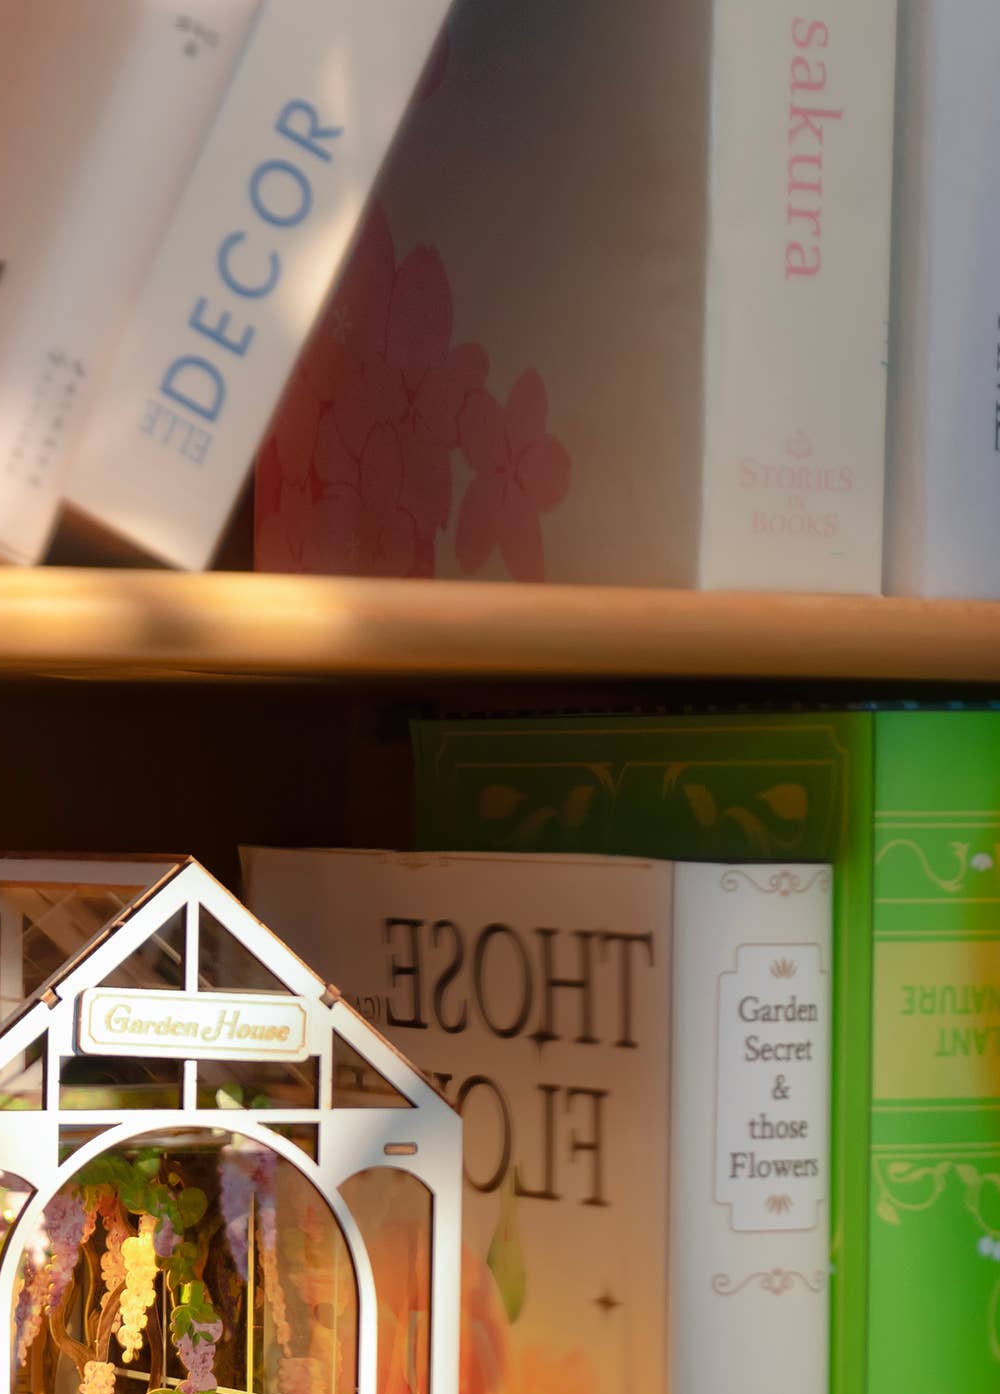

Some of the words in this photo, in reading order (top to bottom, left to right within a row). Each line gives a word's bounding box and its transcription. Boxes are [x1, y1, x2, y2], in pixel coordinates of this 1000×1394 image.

[784, 17, 844, 280] sakura
[158, 98, 343, 423] DECOR
[104, 1003, 198, 1038] Garden
[200, 1009, 290, 1042] House
[738, 996, 818, 1023] Garden
[744, 1035, 812, 1062] Secret
[771, 1074, 790, 1100] &
[749, 1113, 808, 1140] those
[729, 1151, 818, 1179] Flowers
